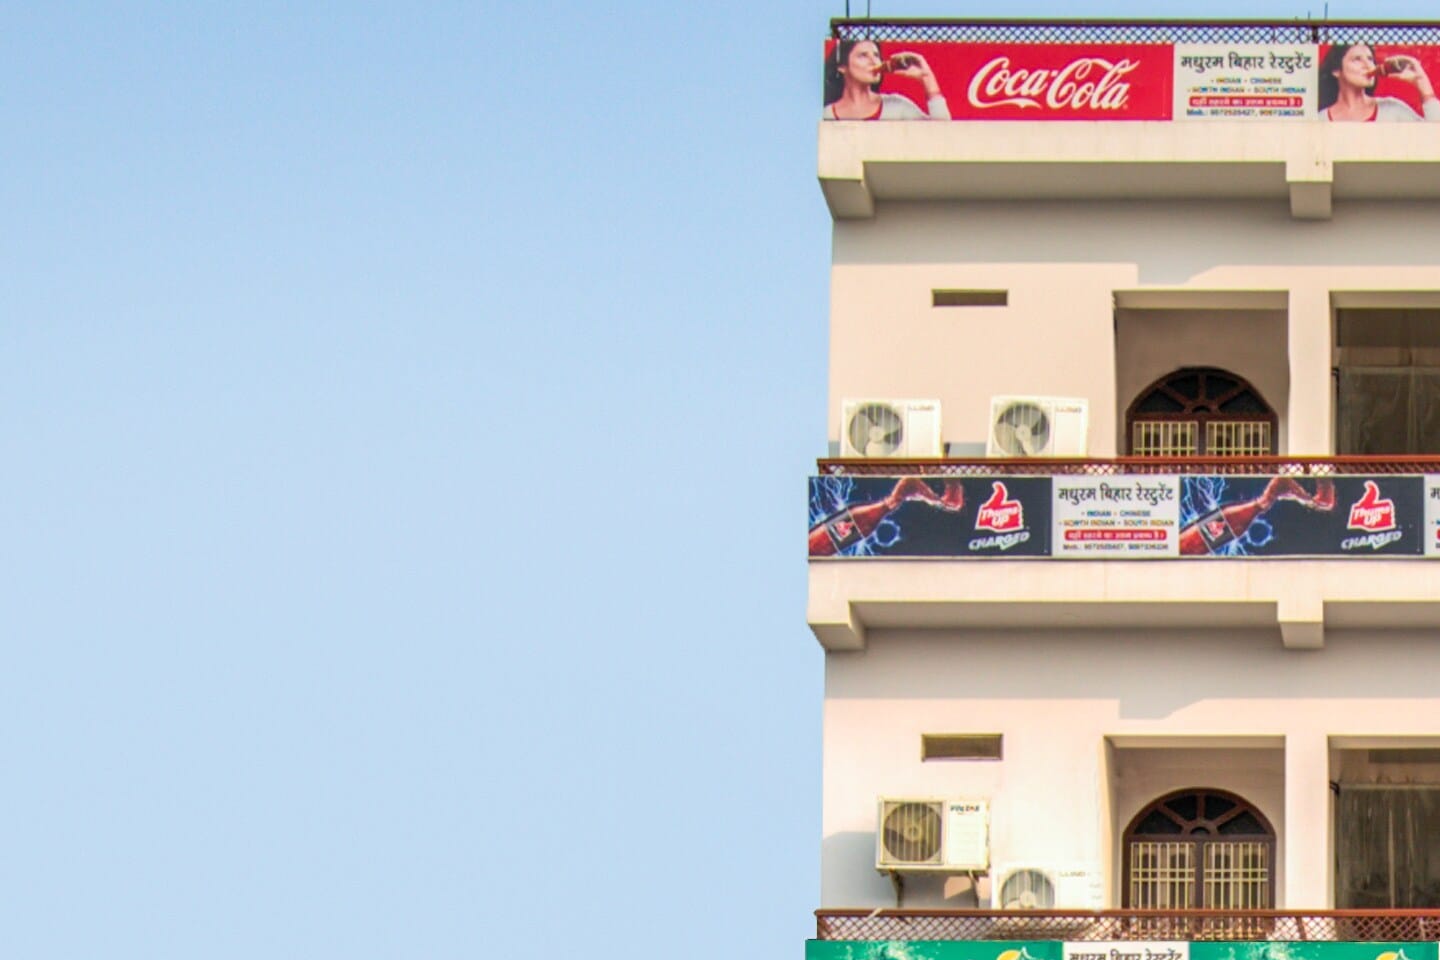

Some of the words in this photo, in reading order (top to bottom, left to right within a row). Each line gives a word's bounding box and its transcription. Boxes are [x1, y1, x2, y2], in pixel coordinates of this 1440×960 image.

[968, 57, 1140, 109] Coca-Cola
[968, 531, 1030, 550] CHARGED
[1341, 530, 1402, 549] CHARGED
